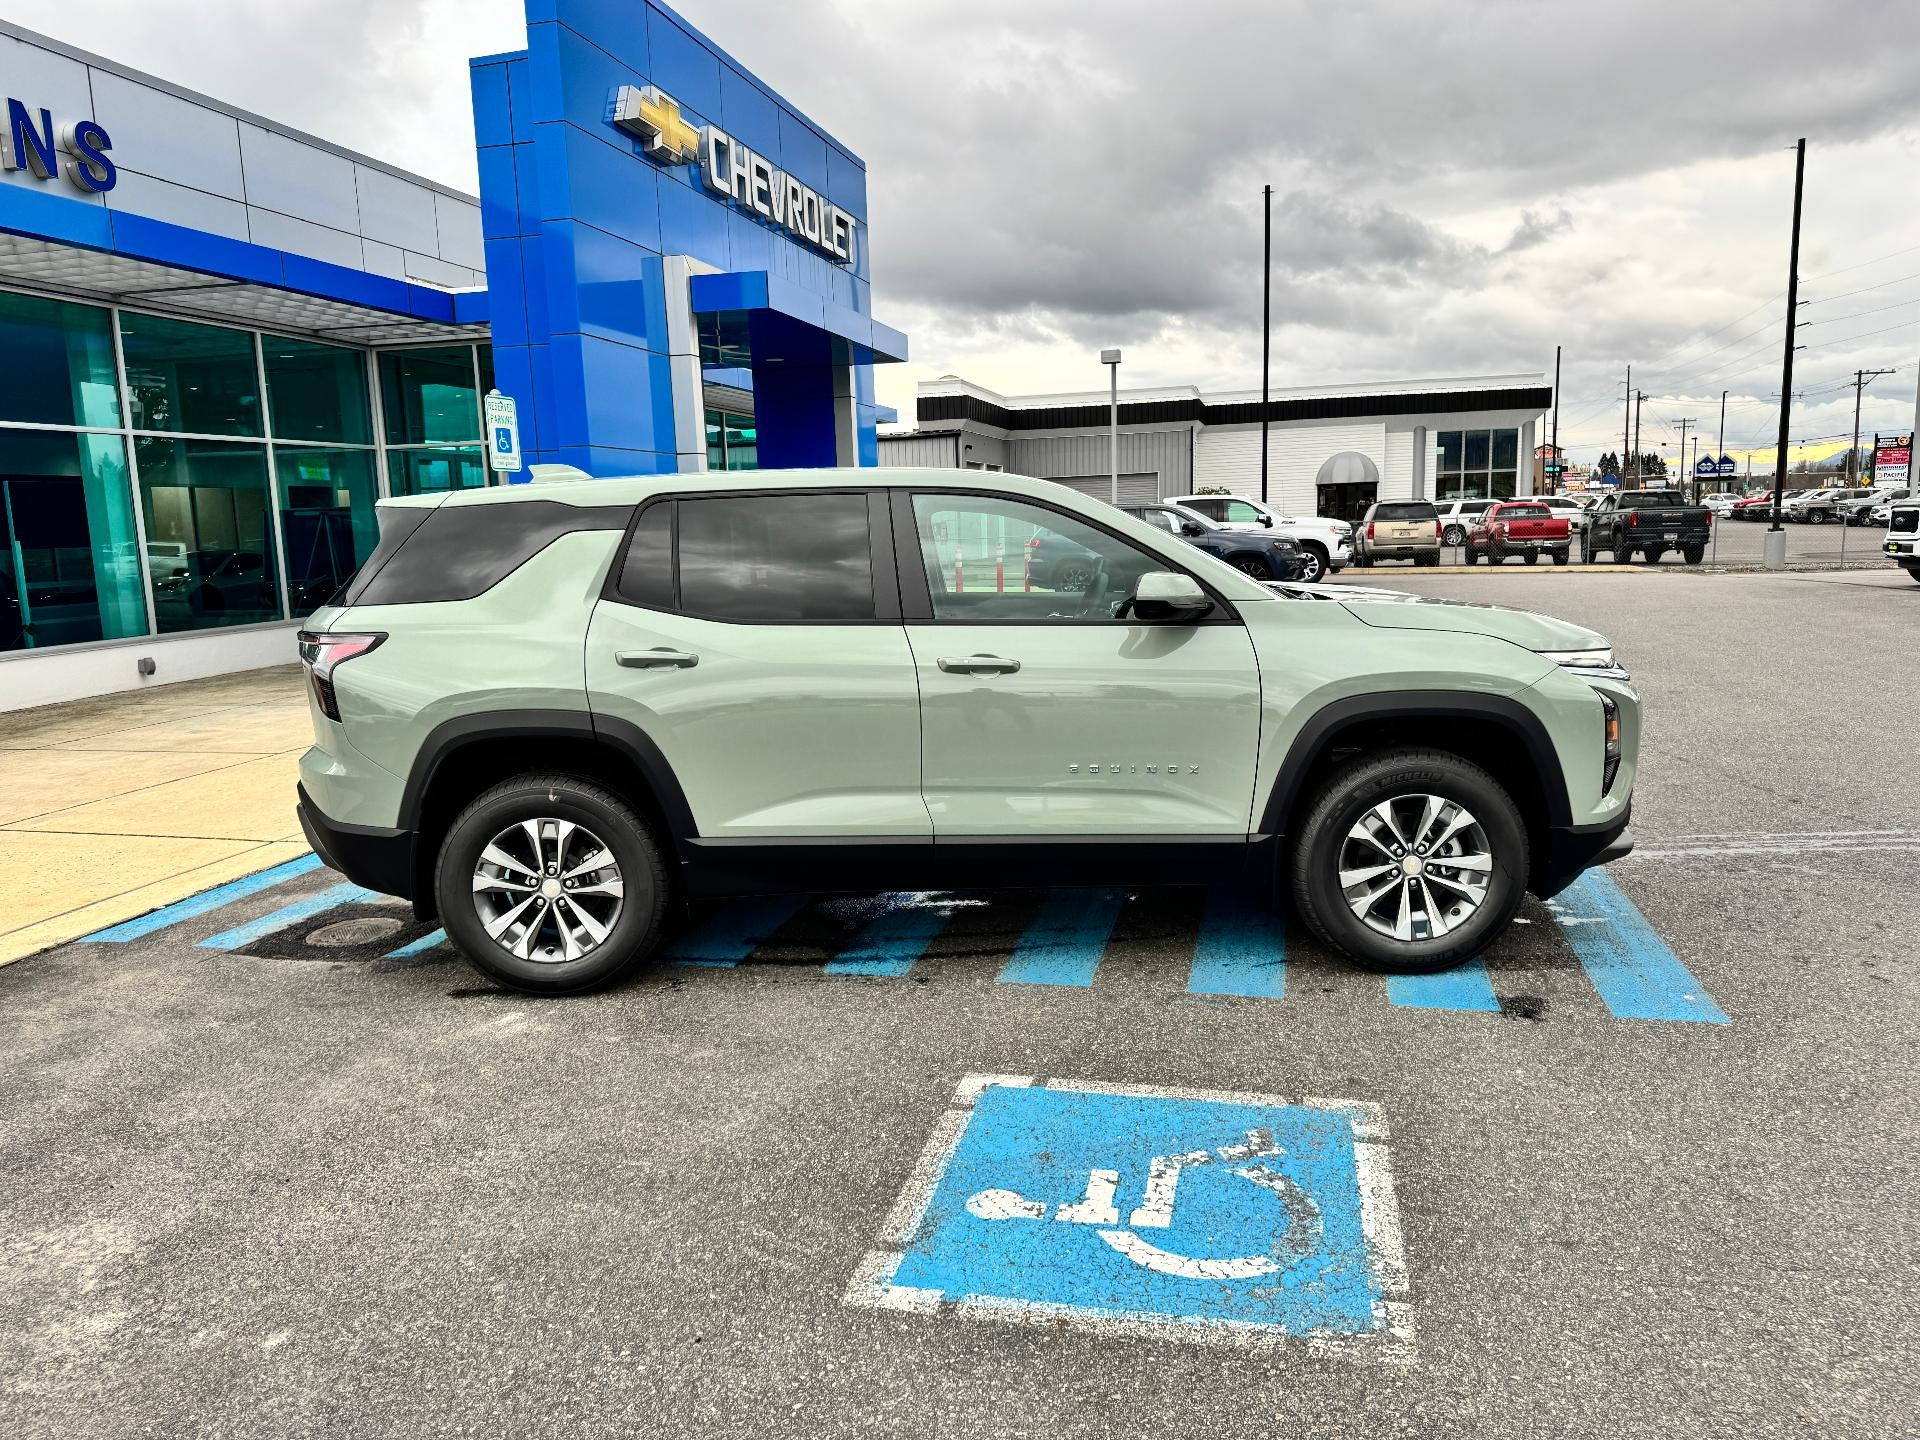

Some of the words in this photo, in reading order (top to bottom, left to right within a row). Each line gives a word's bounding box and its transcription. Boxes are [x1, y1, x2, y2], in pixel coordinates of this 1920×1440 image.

[702, 125, 856, 264] CHEVROLET
[487, 401, 512, 412] RESERVED
[490, 414, 512, 425] PARKING
[1068, 764, 1200, 775] EQUINOX
[1380, 772, 1443, 788] MICHELIN
